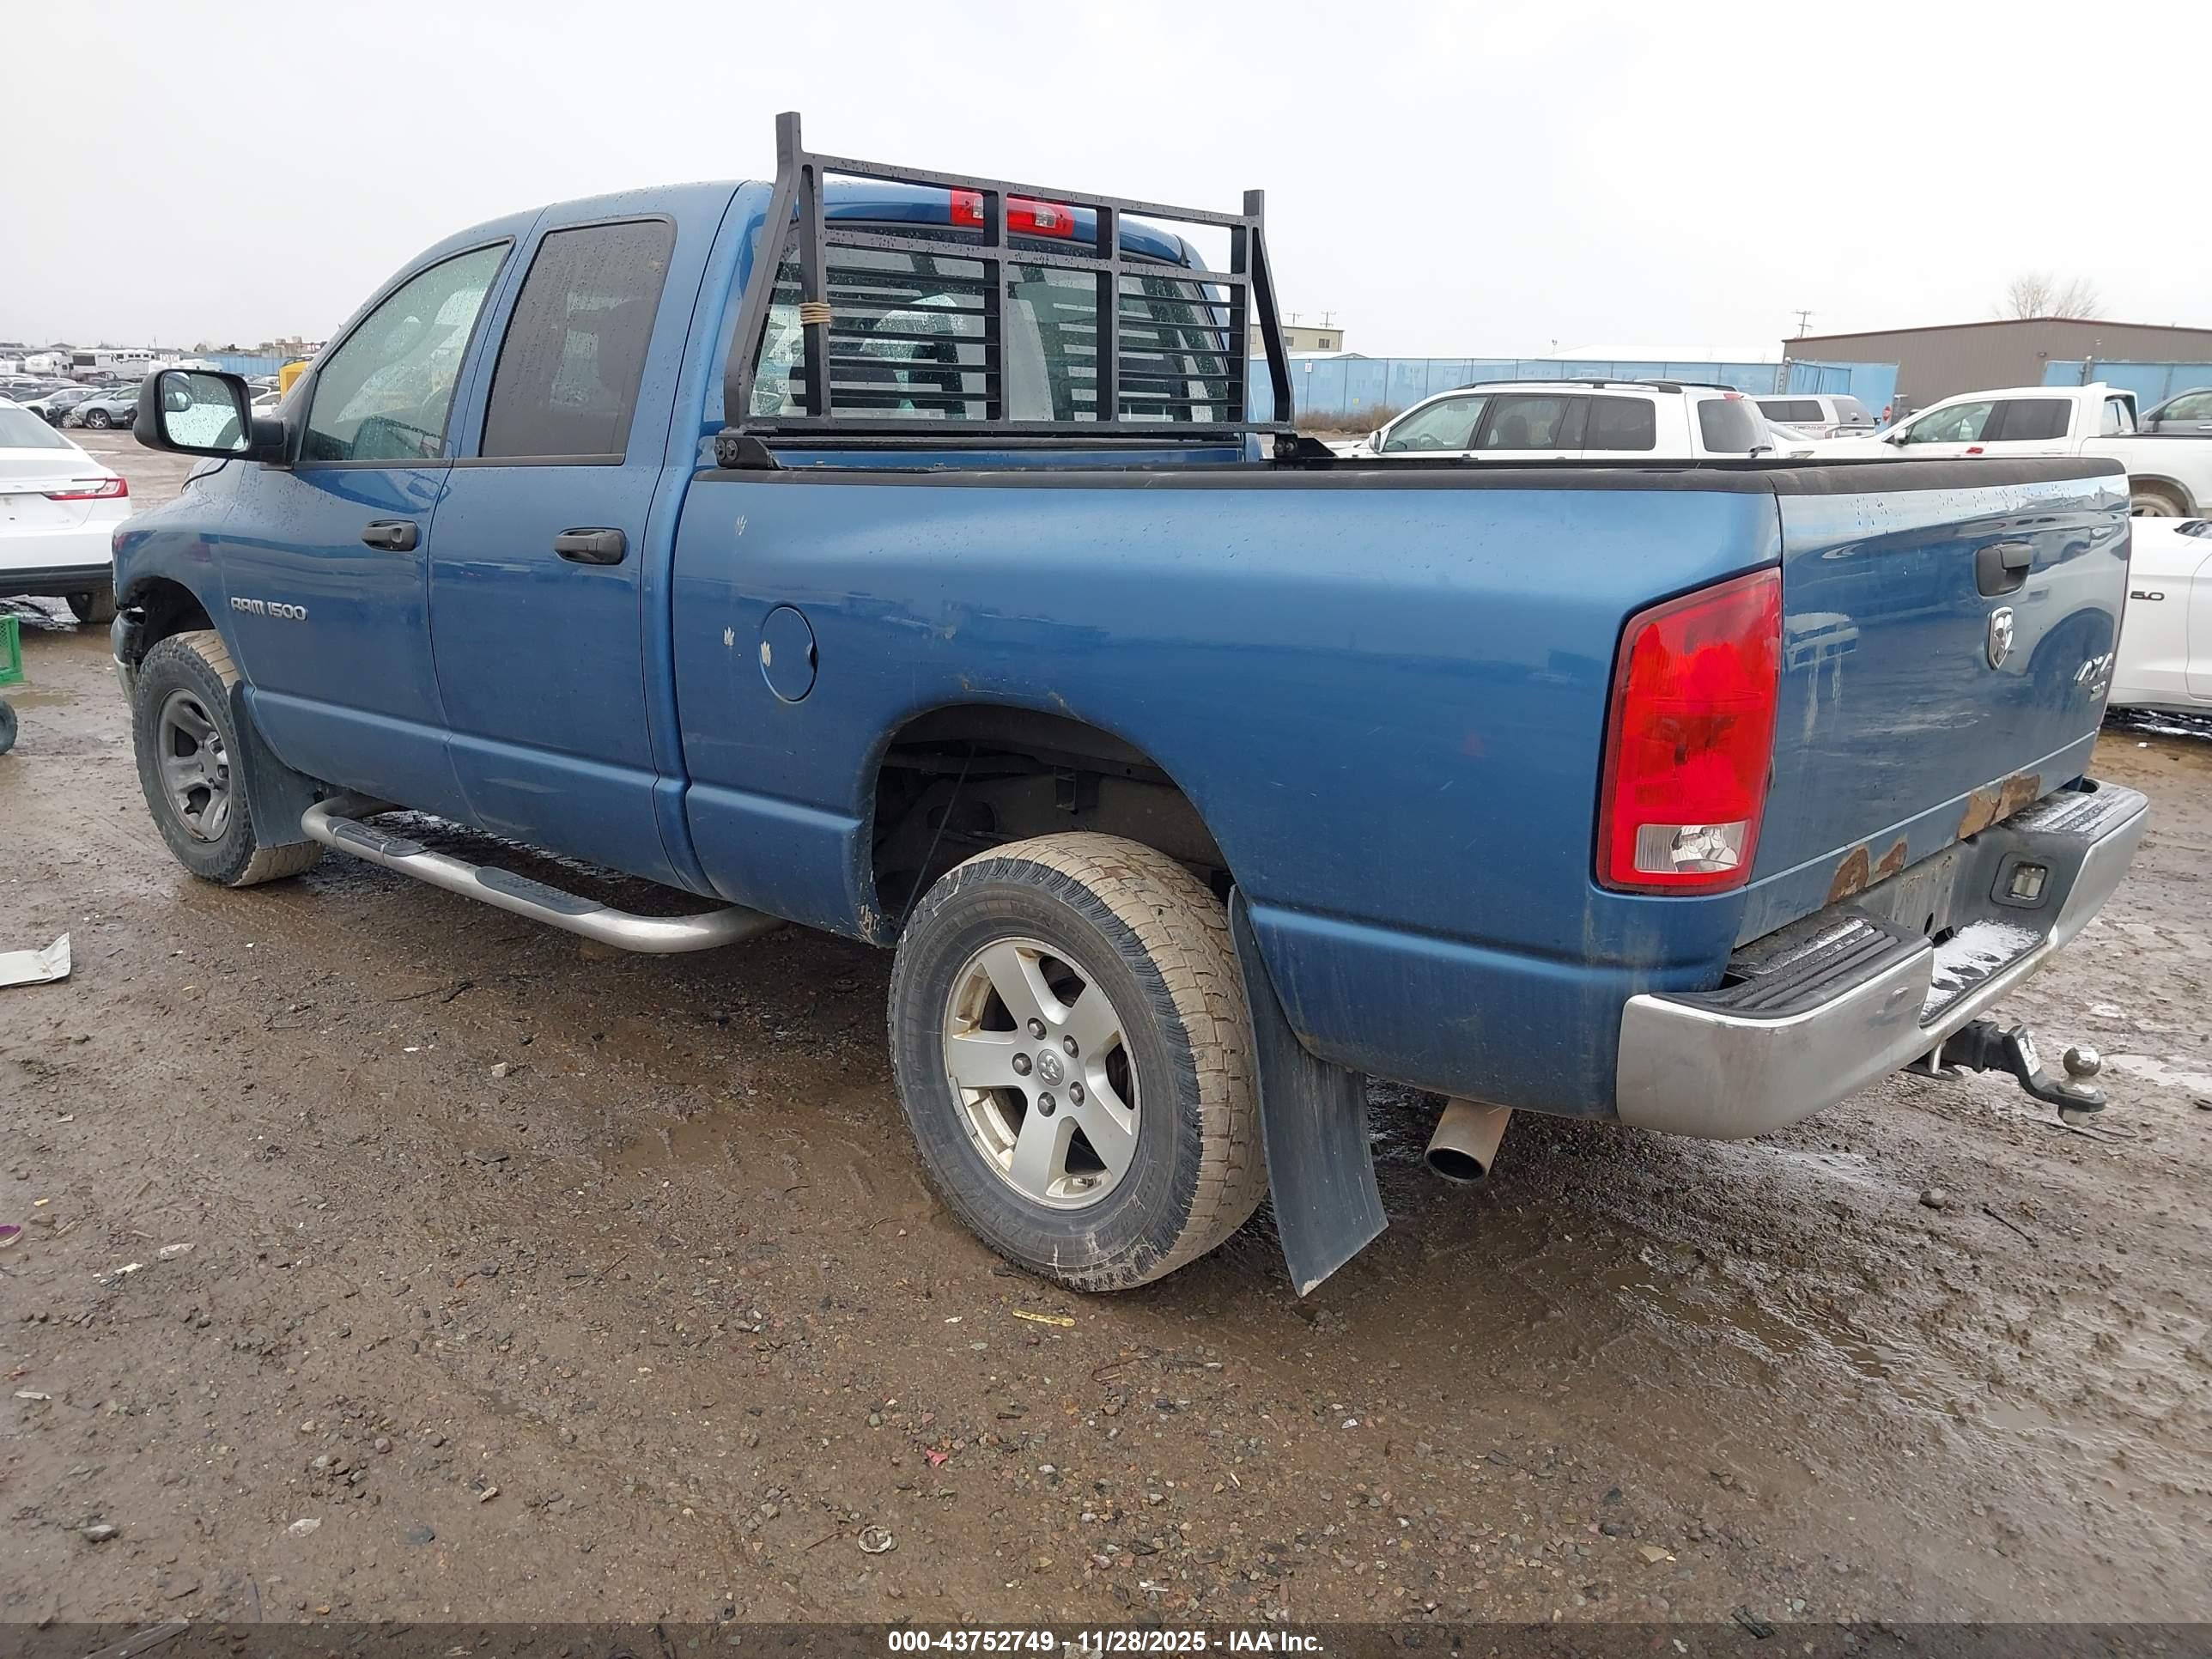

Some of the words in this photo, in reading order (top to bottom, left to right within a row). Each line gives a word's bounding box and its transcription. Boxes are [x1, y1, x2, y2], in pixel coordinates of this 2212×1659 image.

[2130, 591, 2165, 601] 5.0
[230, 597, 264, 615] RAM
[266, 601, 307, 621] 1500
